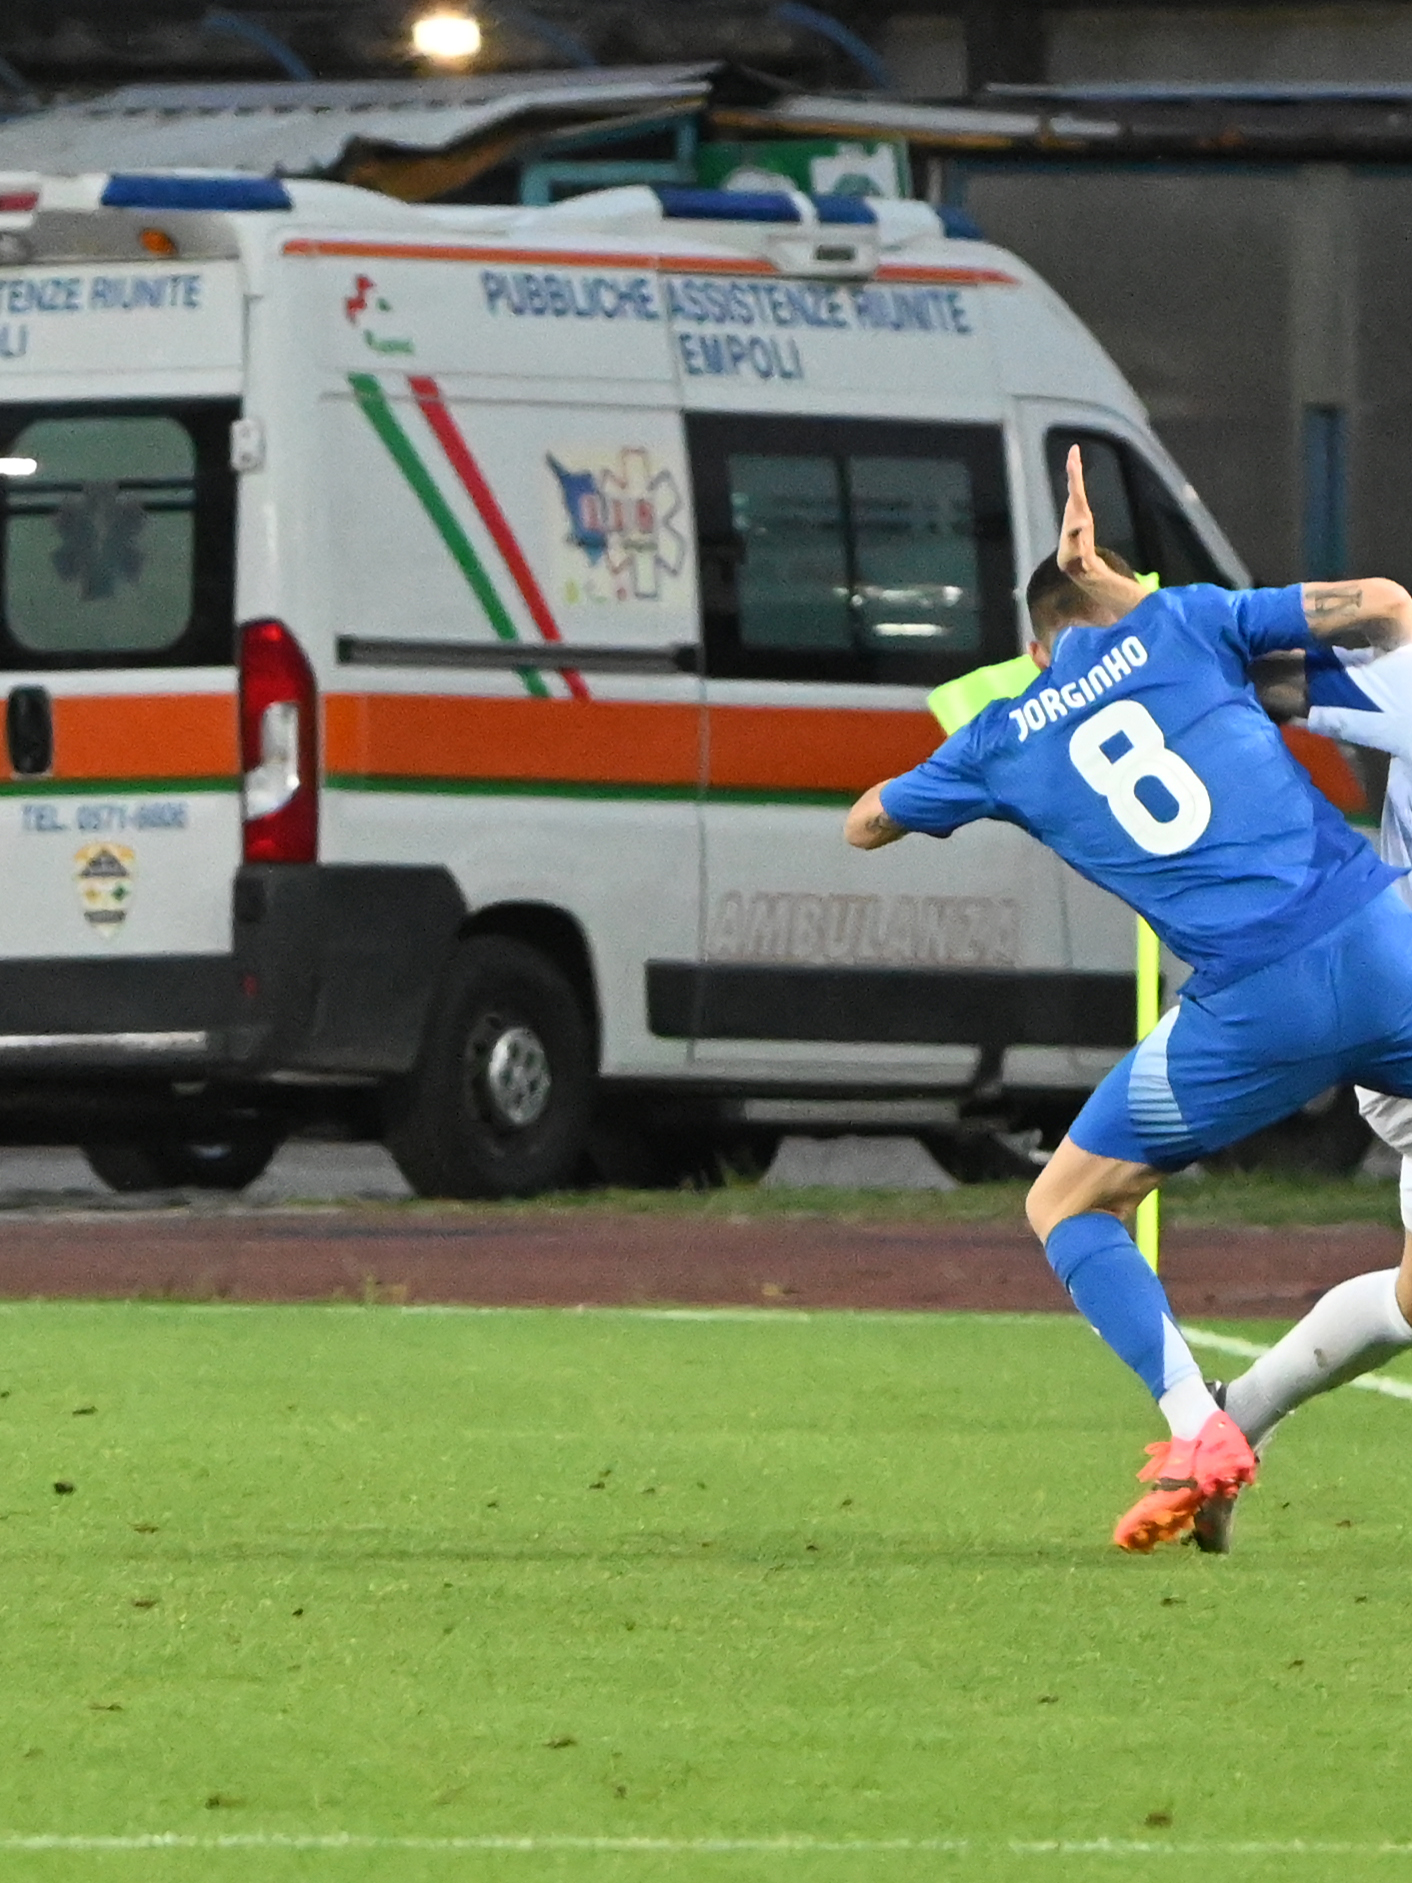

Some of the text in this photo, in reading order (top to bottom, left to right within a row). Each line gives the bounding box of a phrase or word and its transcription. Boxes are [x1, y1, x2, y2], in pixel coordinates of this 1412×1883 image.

[483, 269, 972, 334] PUBBLICHE ASSISTENZE RIUNITE
[679, 332, 803, 380] EMPOLI
[1009, 636, 1148, 742] JORGINHO
[1069, 700, 1211, 856] 8
